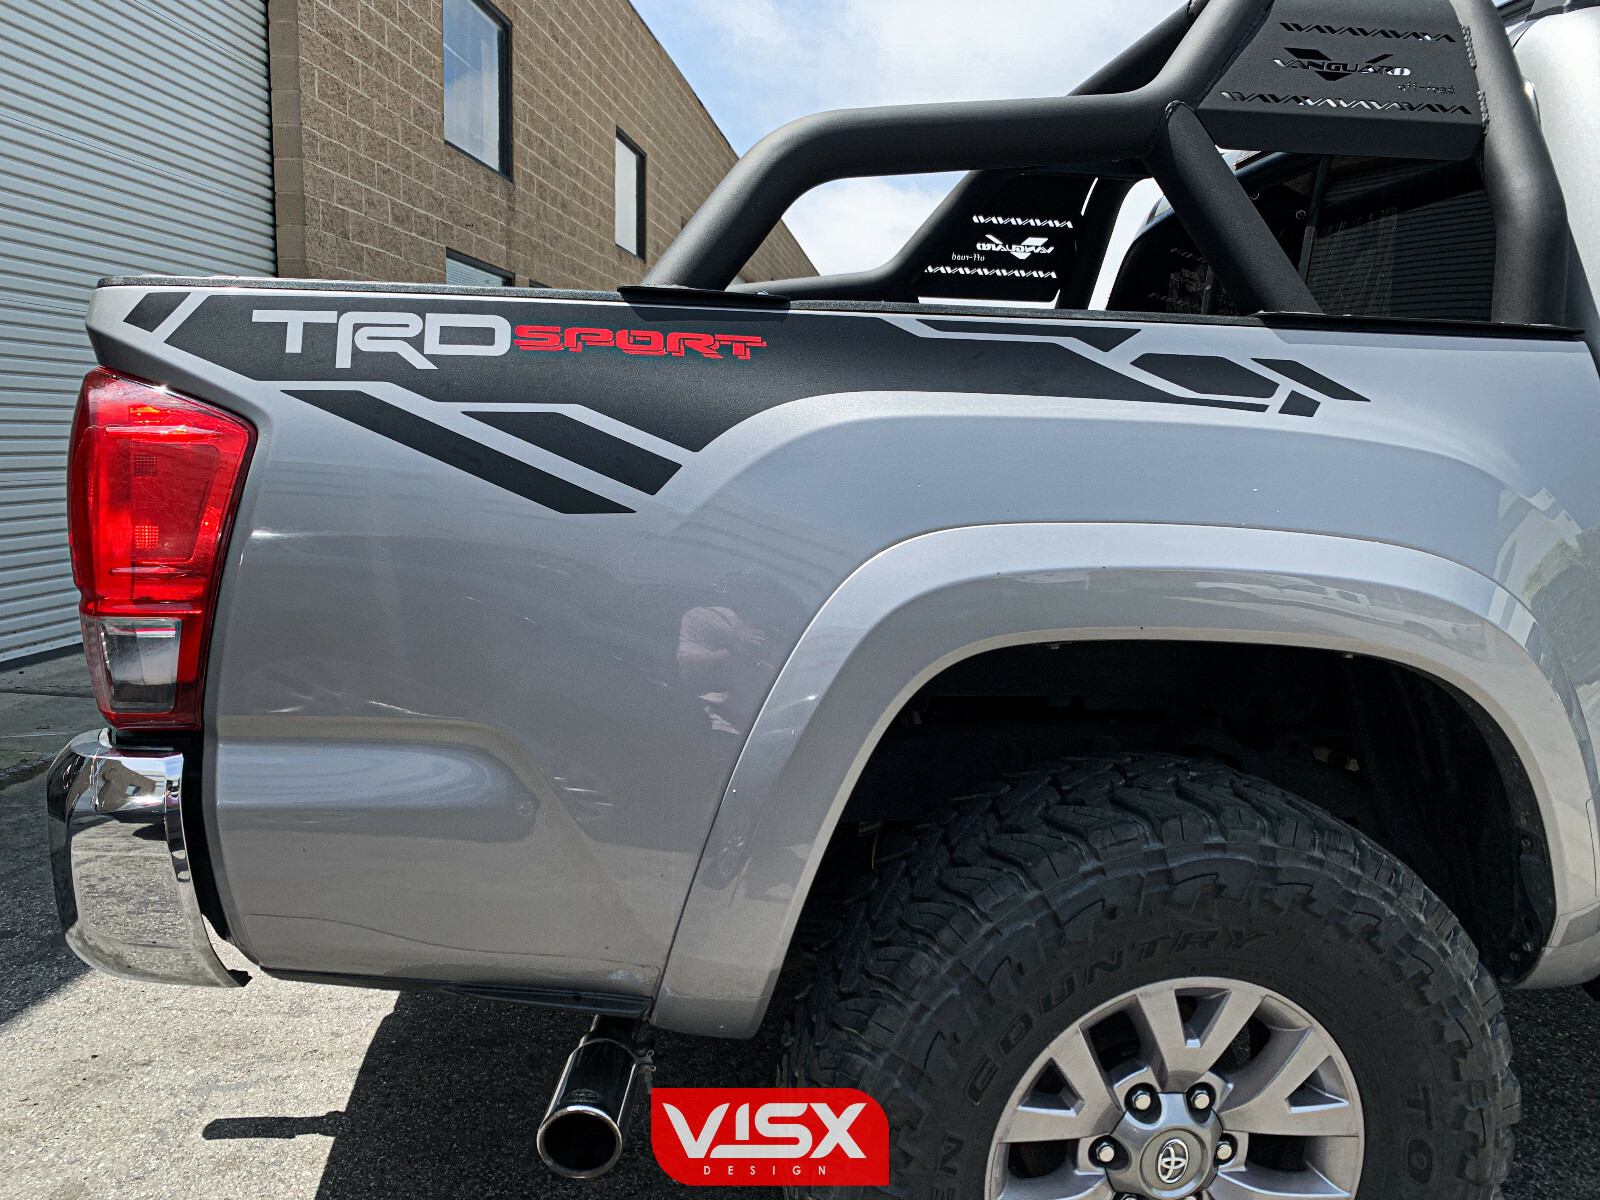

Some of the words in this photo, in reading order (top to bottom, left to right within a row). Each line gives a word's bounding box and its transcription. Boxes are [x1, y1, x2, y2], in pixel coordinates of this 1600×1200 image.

[1273, 57, 1411, 77] VANGUARD
[251, 309, 512, 370] TRD
[513, 323, 768, 361] SPORT
[964, 928, 1269, 1106] COUNTRY
